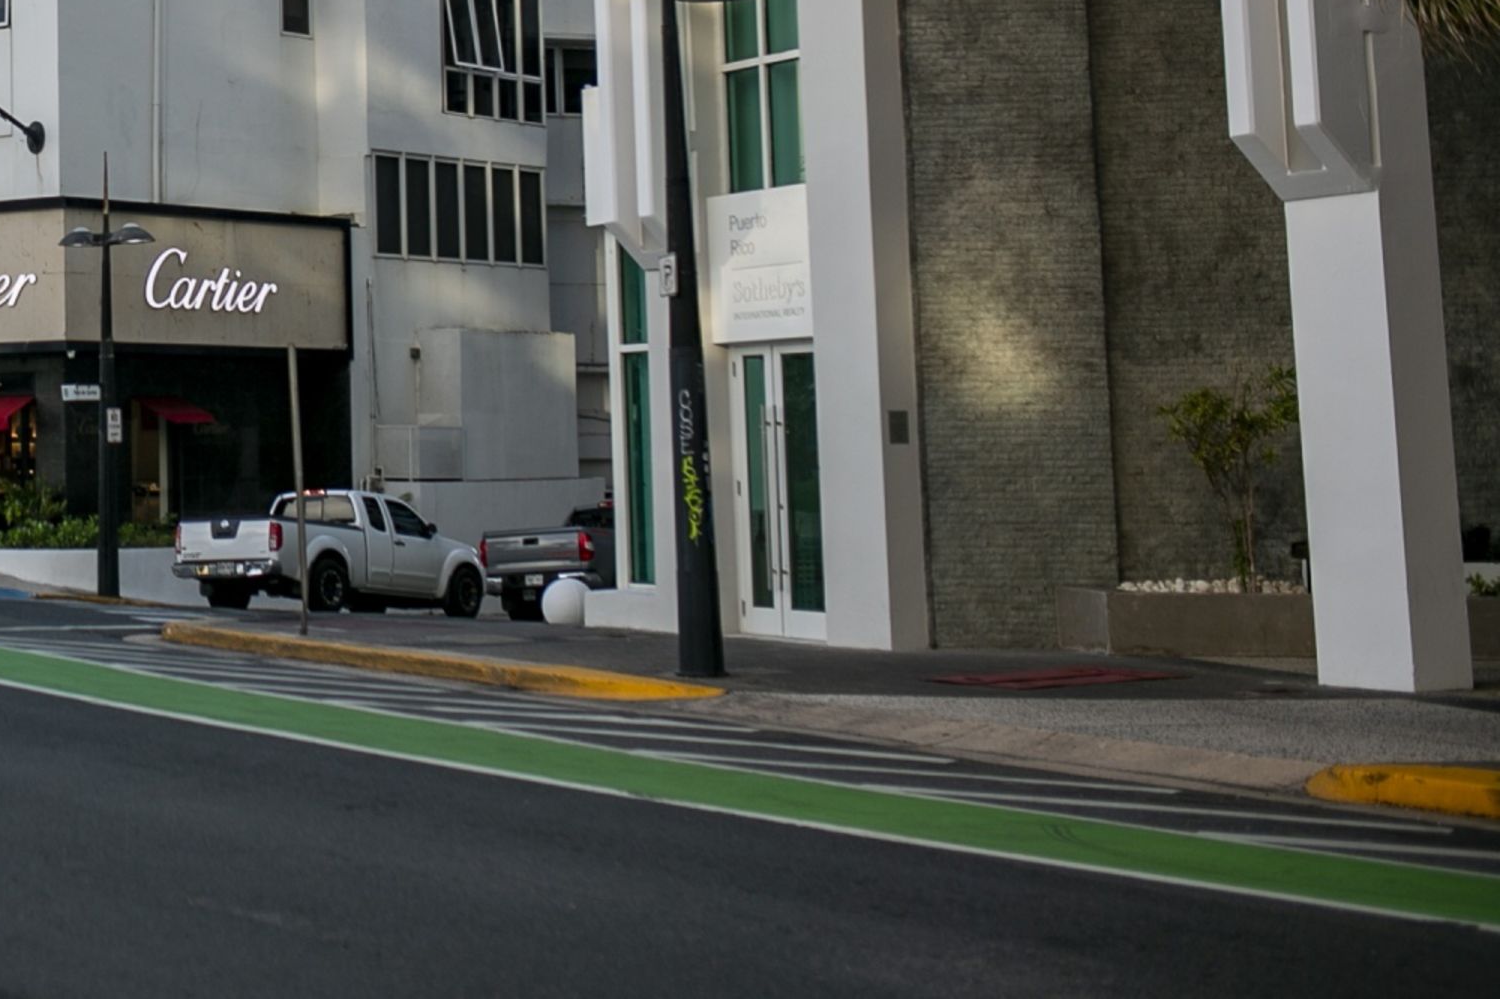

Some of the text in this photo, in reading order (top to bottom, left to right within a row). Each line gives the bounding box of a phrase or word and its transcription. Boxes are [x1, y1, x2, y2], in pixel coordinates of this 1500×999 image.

[728, 213, 767, 232] Puerto
[730, 239, 756, 256] Rico
[145, 248, 278, 313] Cartier
